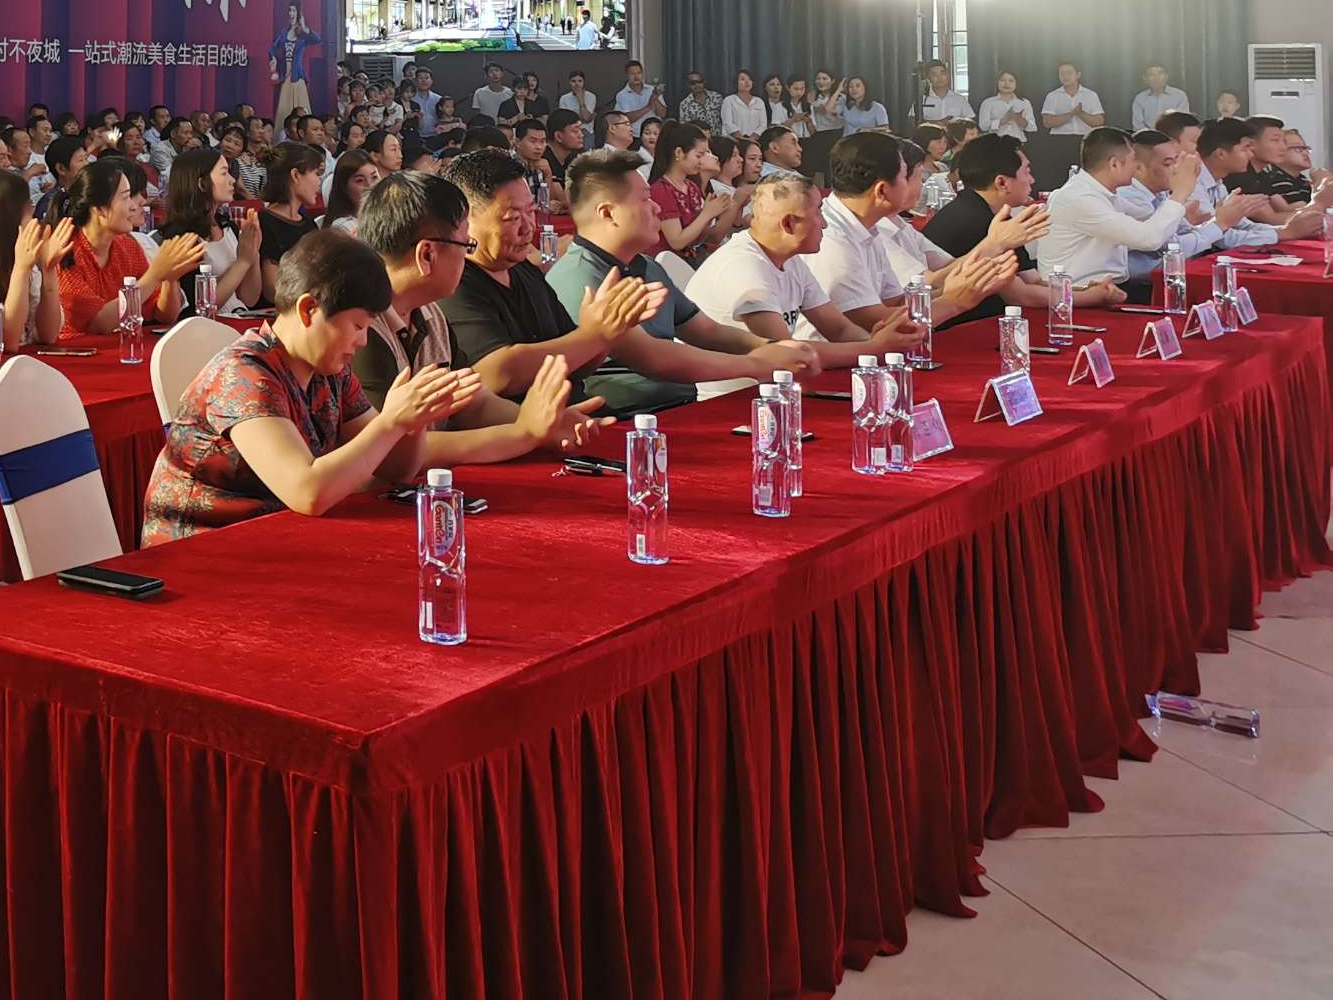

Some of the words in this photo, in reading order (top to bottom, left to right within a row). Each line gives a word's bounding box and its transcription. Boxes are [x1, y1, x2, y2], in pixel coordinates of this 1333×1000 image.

[68, 40, 249, 68] 一站式潮流美食生活目的地
